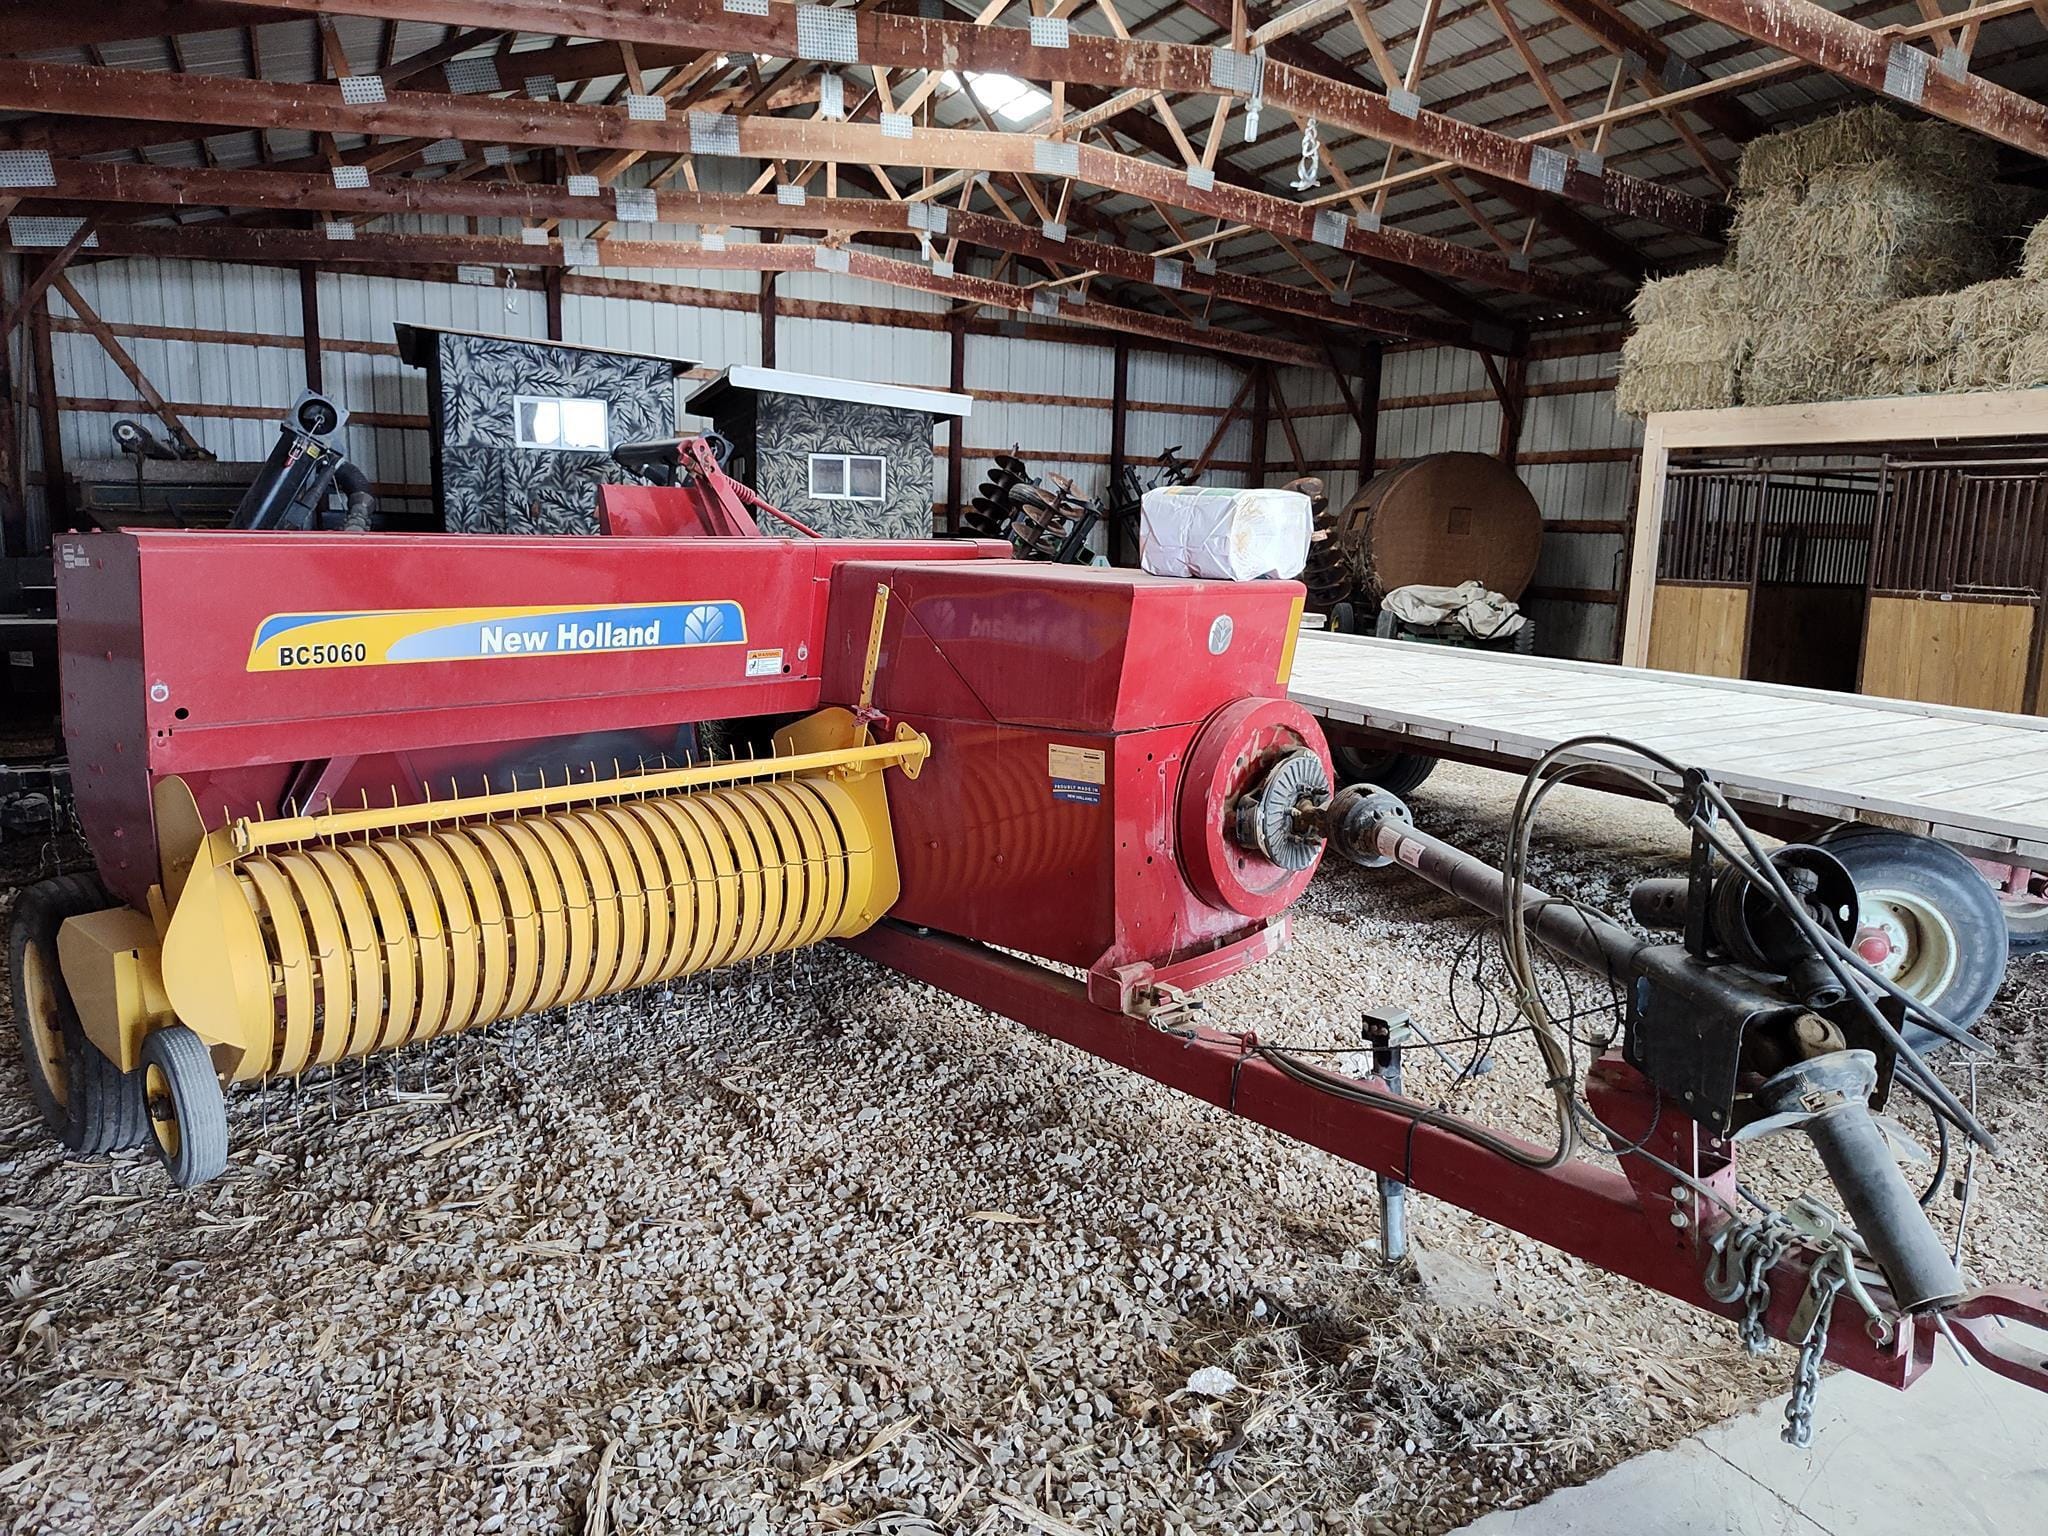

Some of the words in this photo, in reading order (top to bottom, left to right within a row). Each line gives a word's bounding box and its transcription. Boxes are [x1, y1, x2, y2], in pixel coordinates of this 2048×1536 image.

[479, 625, 551, 654] New
[556, 619, 660, 650] Holland
[279, 643, 367, 667] BC5060
